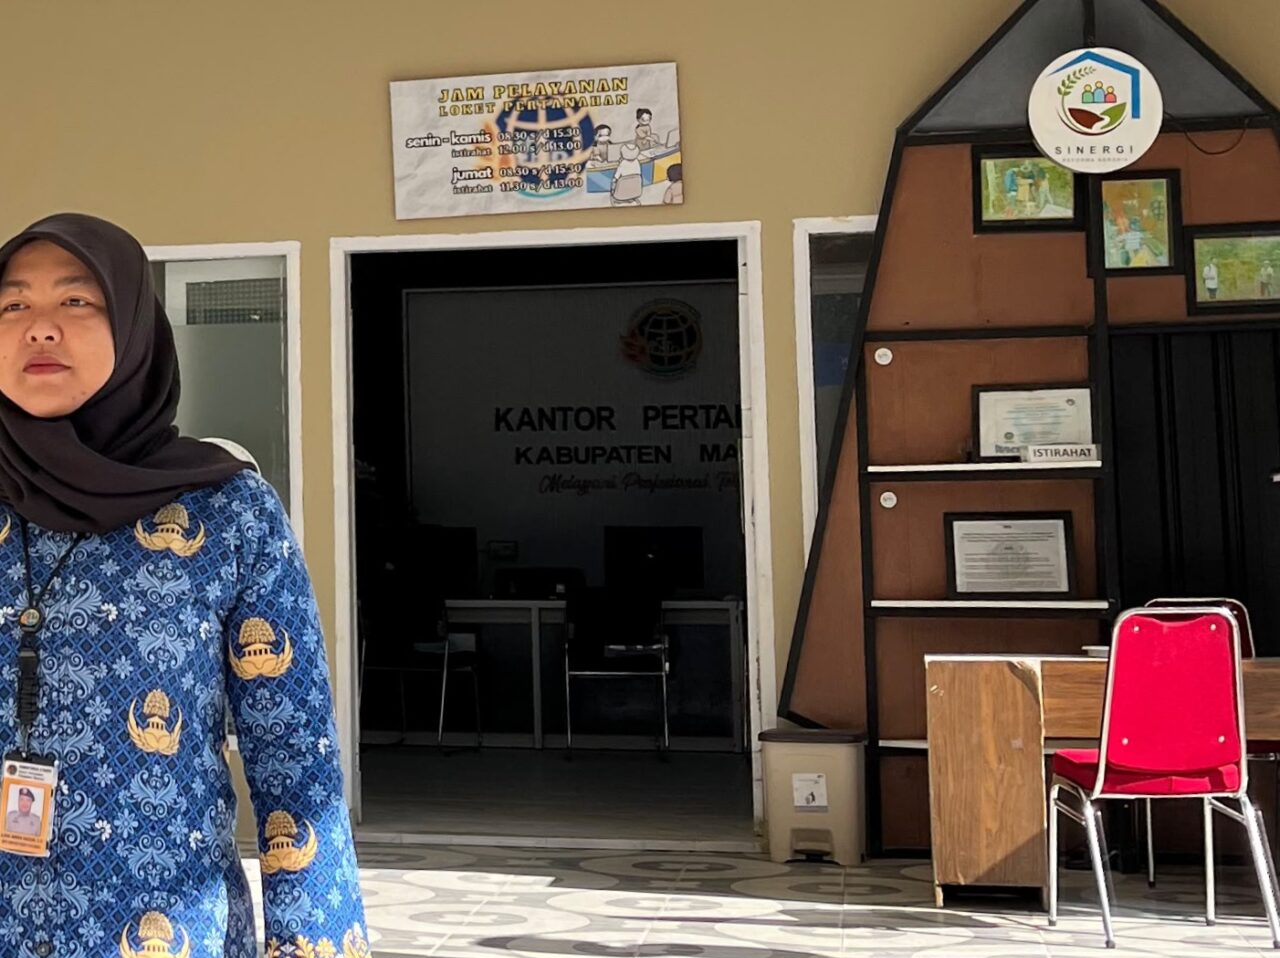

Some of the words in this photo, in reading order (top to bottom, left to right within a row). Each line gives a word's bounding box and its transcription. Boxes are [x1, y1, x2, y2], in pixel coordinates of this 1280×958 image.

[438, 87, 485, 103] JAM
[493, 77, 628, 99] PELAYANAN
[439, 102, 496, 117] LOKET
[503, 94, 629, 113] PERTANAHAN
[406, 133, 442, 148] senin
[450, 129, 493, 145] kamis
[451, 147, 492, 158] istirahat
[1055, 145, 1133, 155] SINERGI
[451, 166, 494, 184] jumat
[453, 184, 493, 195] istirahat
[494, 406, 616, 432] KANTOR
[515, 445, 672, 465] KABUPATEN
[1033, 447, 1093, 458] ISTIRAHAT
